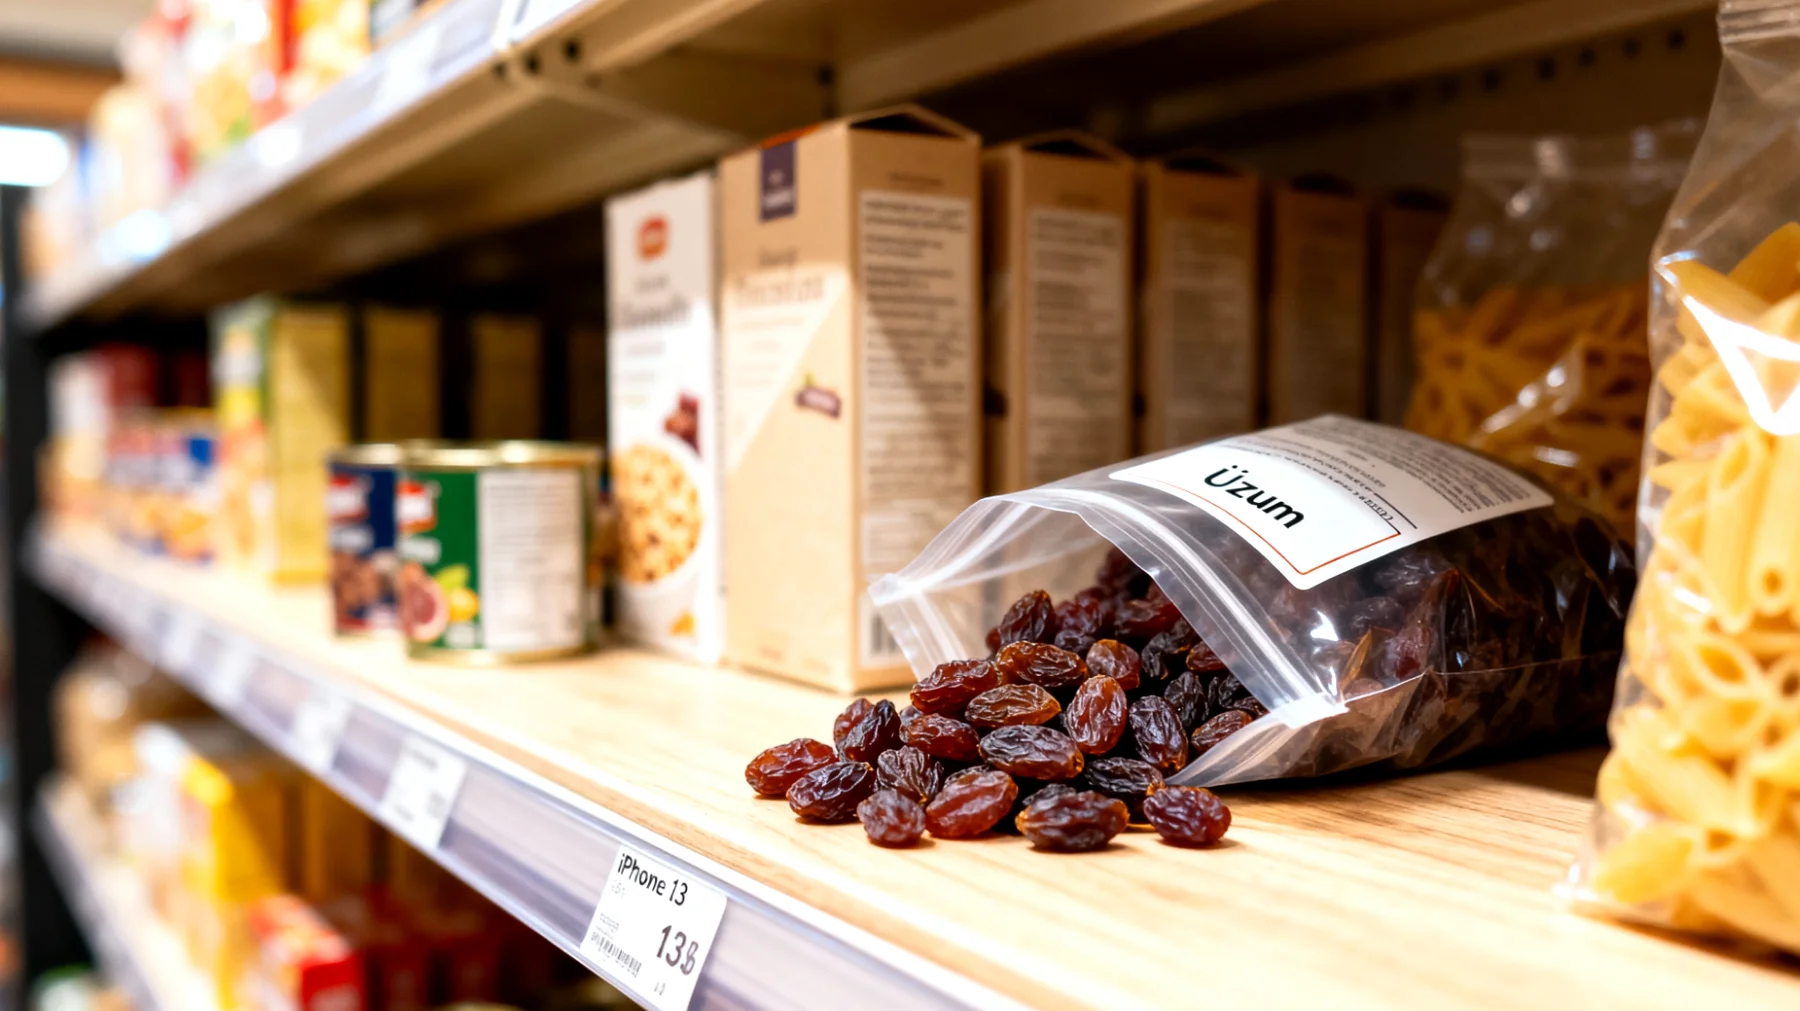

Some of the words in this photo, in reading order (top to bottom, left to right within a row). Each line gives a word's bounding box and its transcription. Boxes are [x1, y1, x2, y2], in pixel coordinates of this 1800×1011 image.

[1204, 465, 1304, 528] Üzum
[617, 853, 667, 896] iPhone
[668, 879, 688, 906] 13
